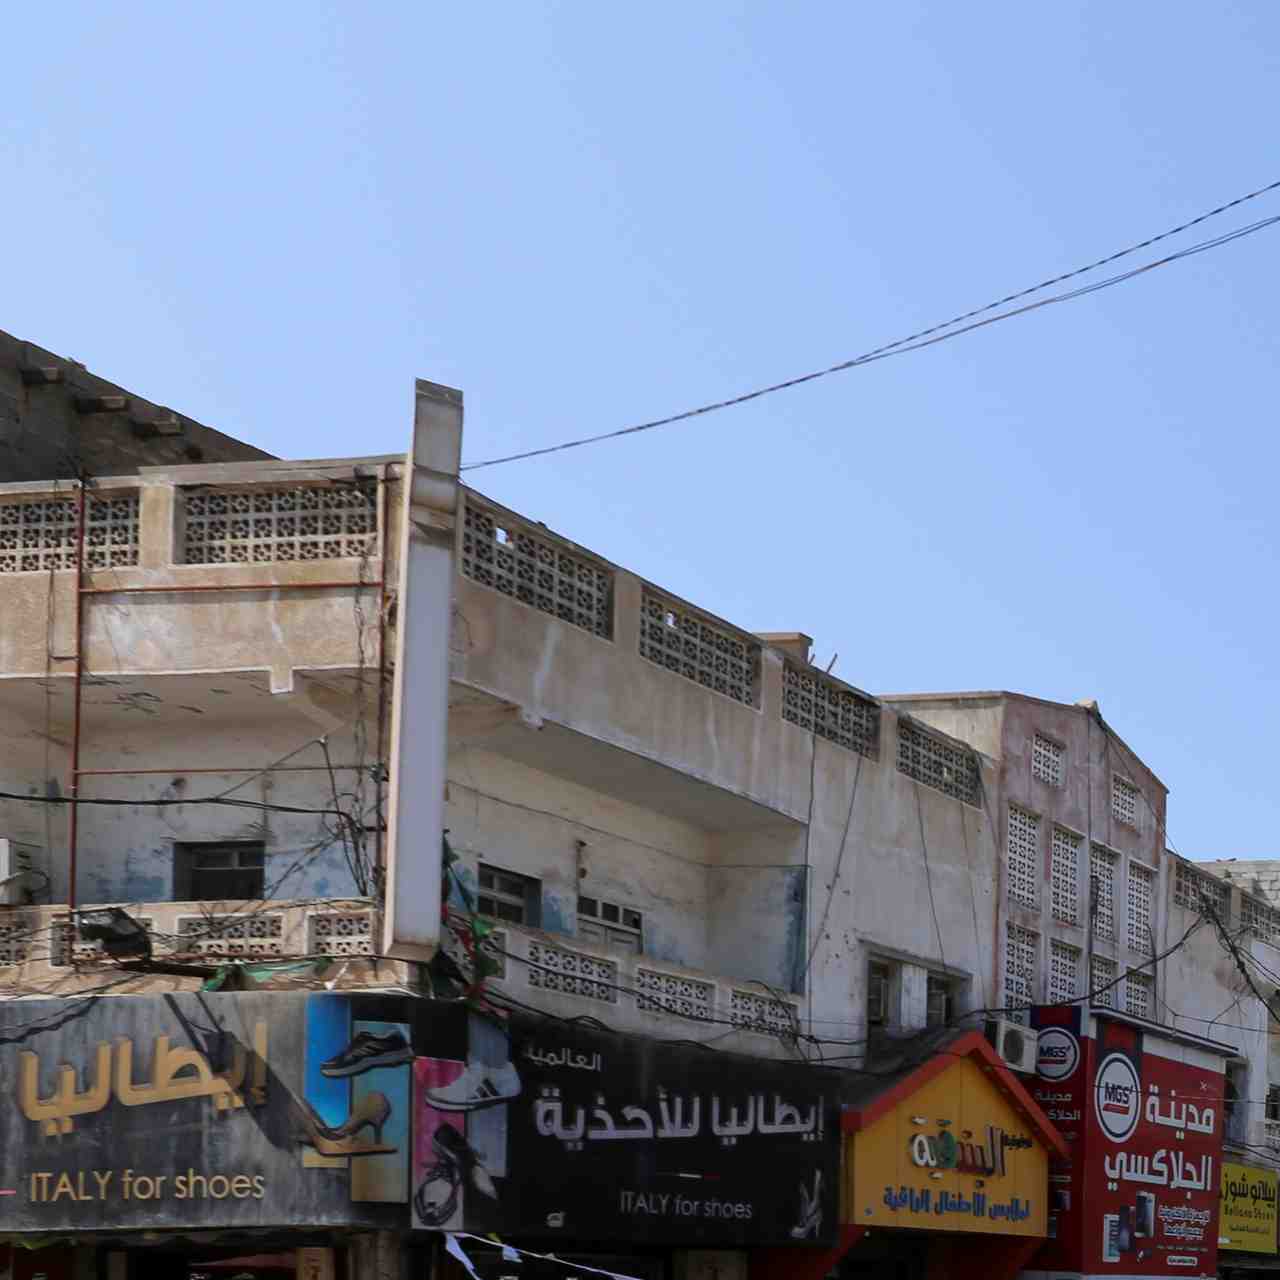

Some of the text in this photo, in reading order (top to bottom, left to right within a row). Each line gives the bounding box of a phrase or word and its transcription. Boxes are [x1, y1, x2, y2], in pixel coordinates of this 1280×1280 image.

[533, 1083, 825, 1151] إيطاليا للأحذية
[1145, 1083, 1215, 1141] مدينة
[30, 1167, 266, 1202] ITALY for shoes
[1104, 1148, 1213, 1201] الجلاكسي
[618, 1190, 753, 1220] ITALY for shoes
